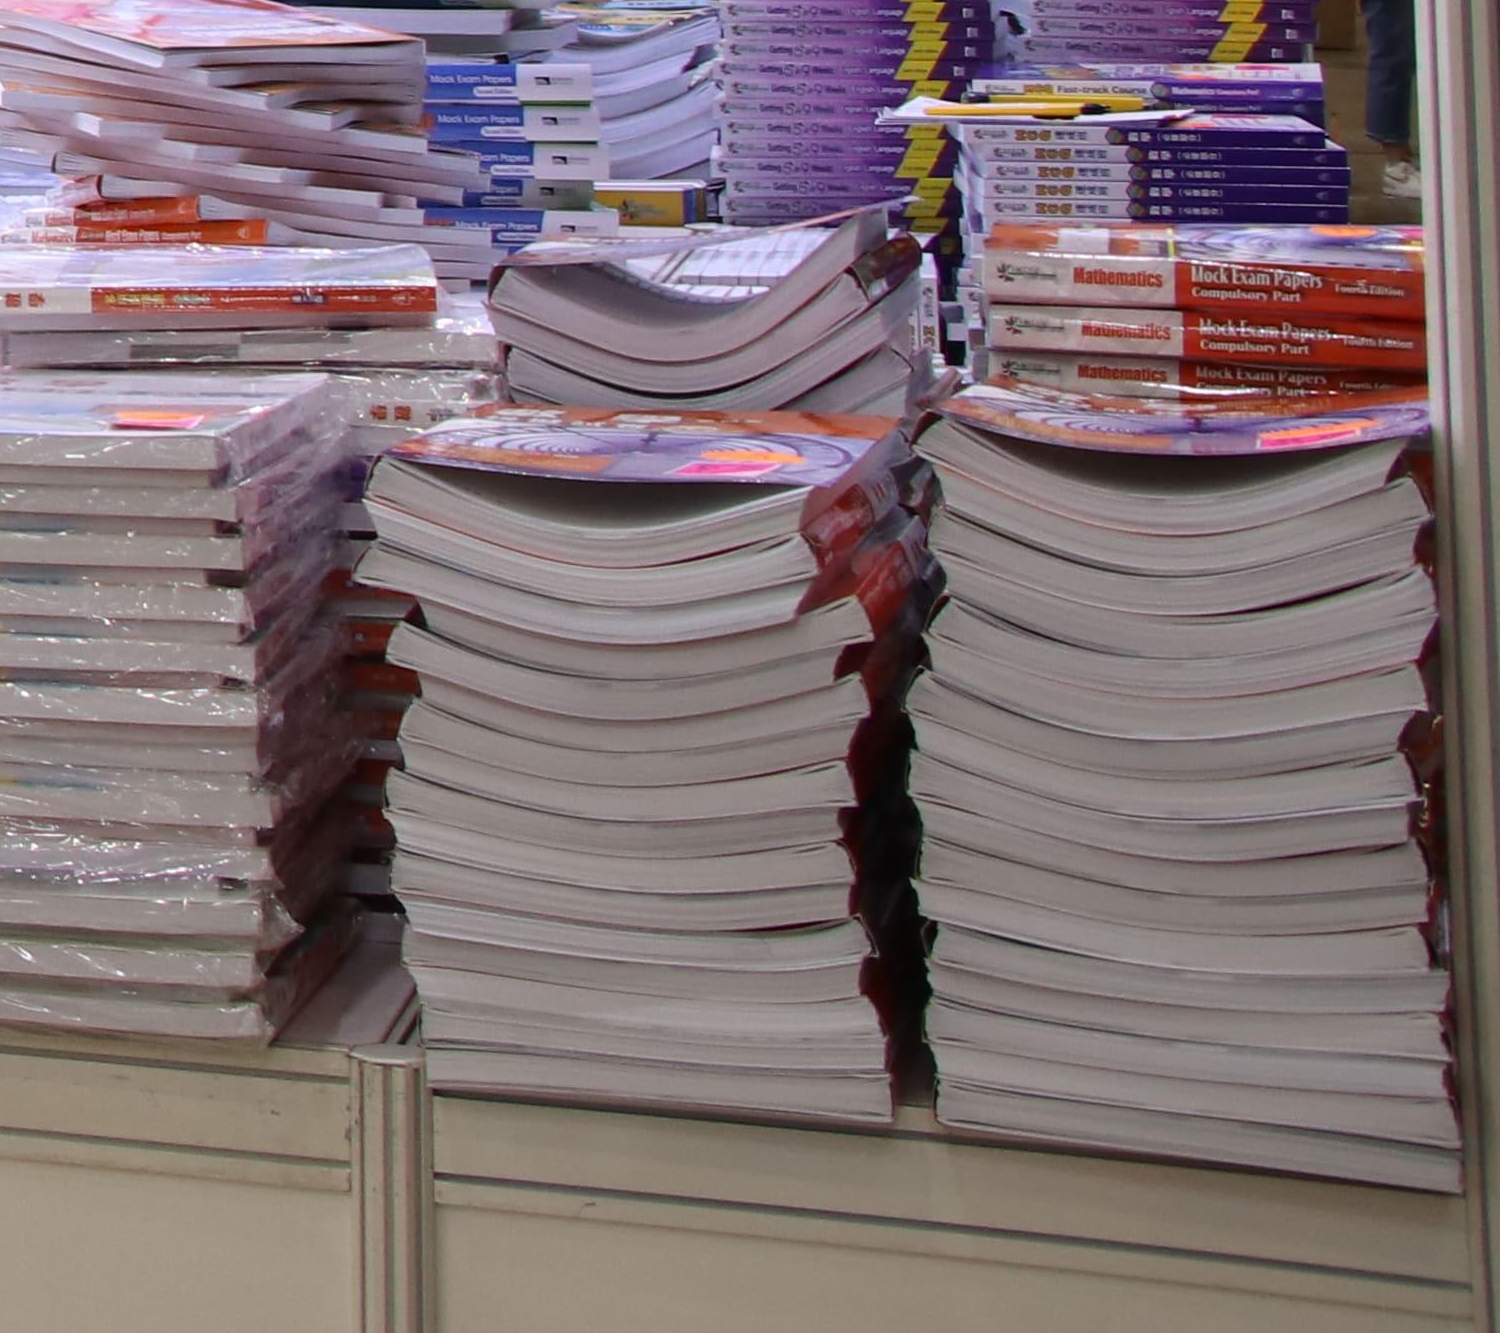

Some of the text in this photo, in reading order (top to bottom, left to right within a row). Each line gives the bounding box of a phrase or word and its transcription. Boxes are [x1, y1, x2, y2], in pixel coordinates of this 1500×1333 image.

[429, 74, 455, 84] Mock
[484, 74, 513, 86] Papers
[437, 114, 462, 124] Mock
[490, 114, 520, 126] Papers
[1072, 266, 1164, 289] Mathematics
[1190, 265, 1229, 285] Mock
[1232, 268, 1271, 288] Exam
[1273, 270, 1324, 293] Papers
[1191, 286, 1301, 304] Compulsory Part
[1081, 320, 1171, 341] Mathematics
[1199, 339, 1310, 356] Compulsory Part
[1077, 363, 1168, 383] Mathematics
